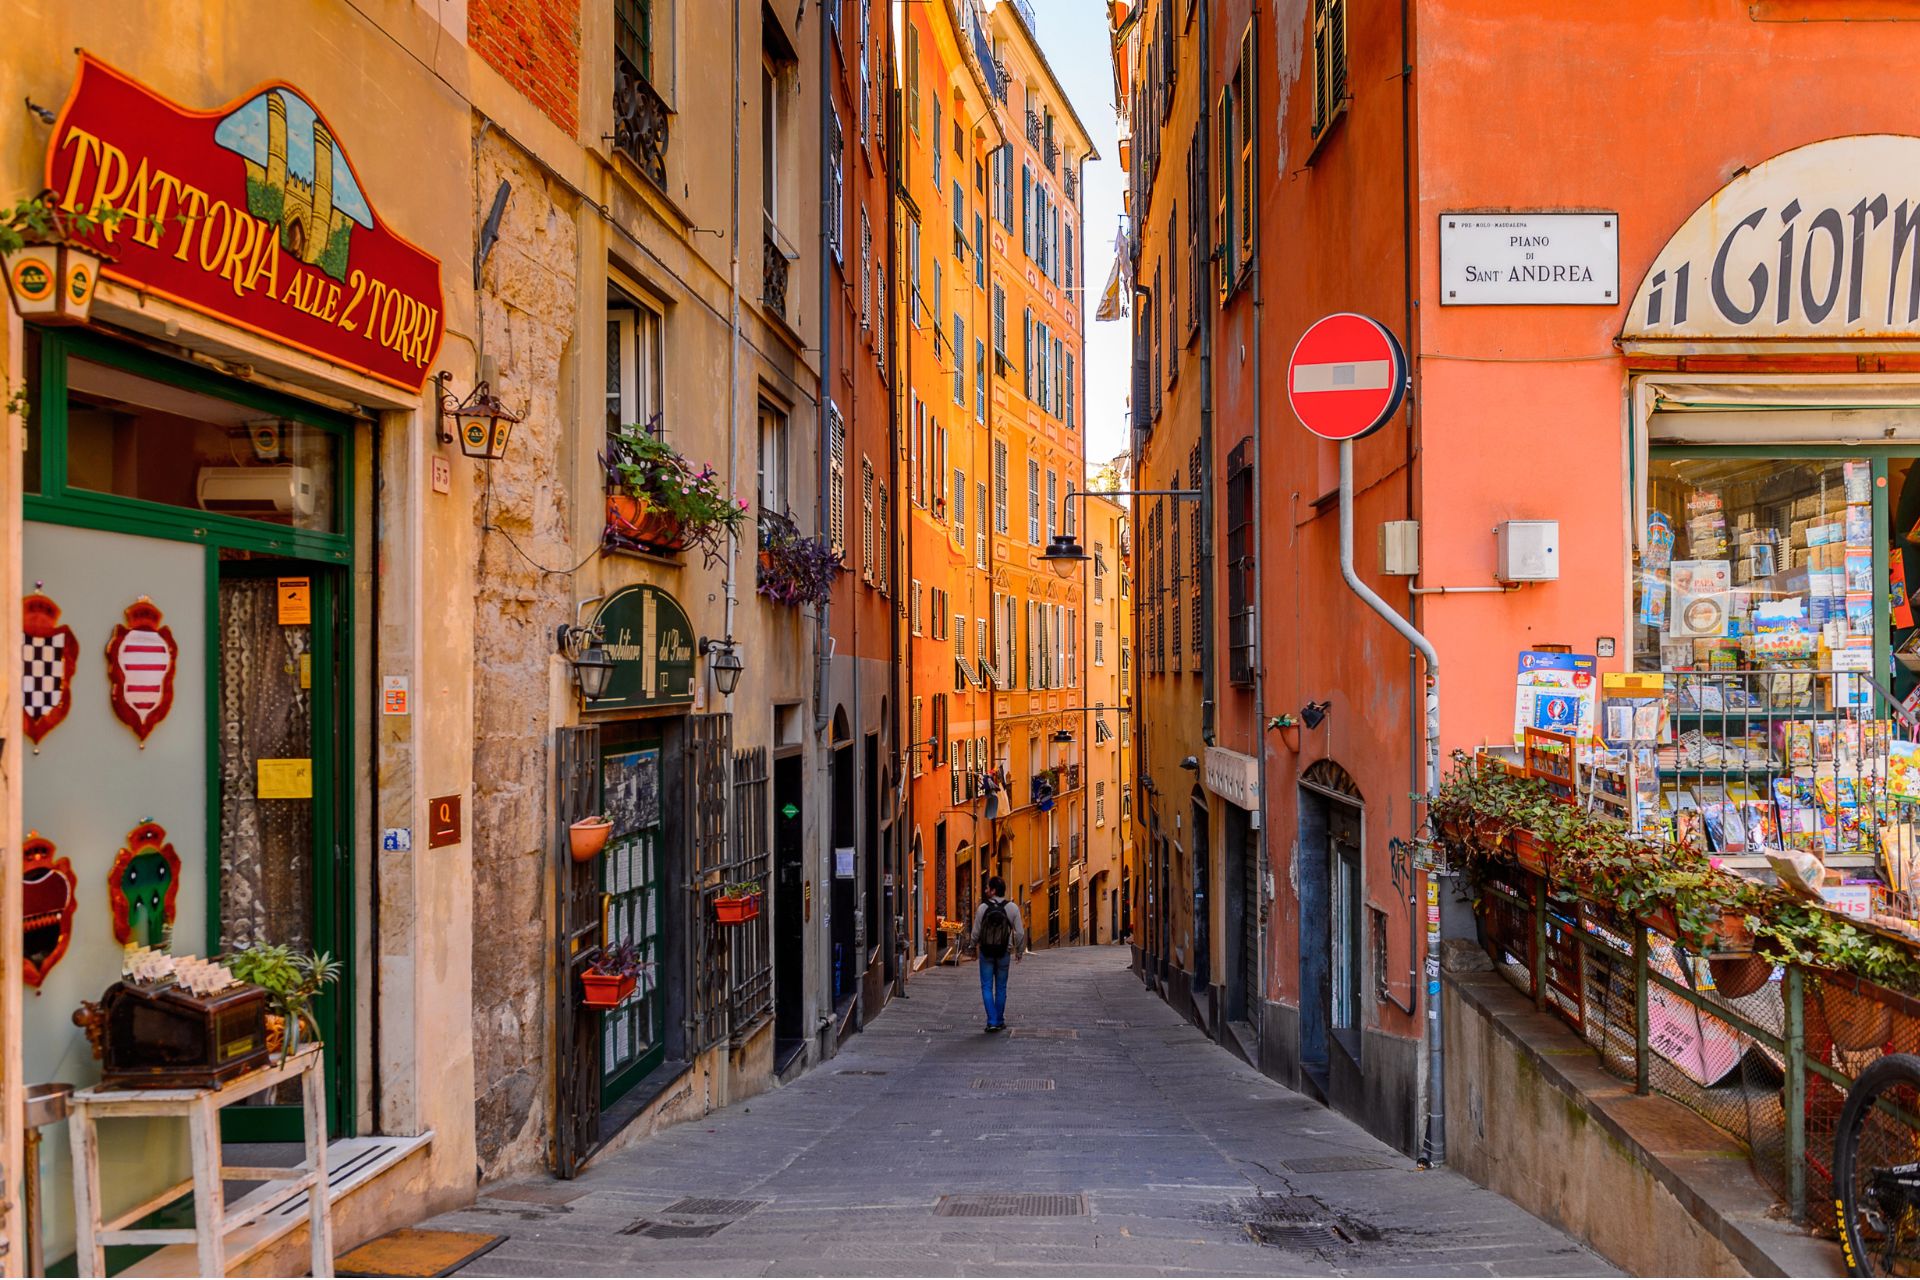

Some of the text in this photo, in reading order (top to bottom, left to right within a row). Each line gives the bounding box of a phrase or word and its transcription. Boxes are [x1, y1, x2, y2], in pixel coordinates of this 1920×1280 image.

[60, 125, 439, 369] TRATTORIA ALLE 2 TORRI
[1510, 236, 1550, 247] PIANO
[1525, 252, 1534, 260] DI
[1508, 265, 1594, 282] ANDREA
[1647, 260, 1690, 326] il
[440, 803, 451, 823] Q
[1835, 1199, 1857, 1268] MAXXIS
